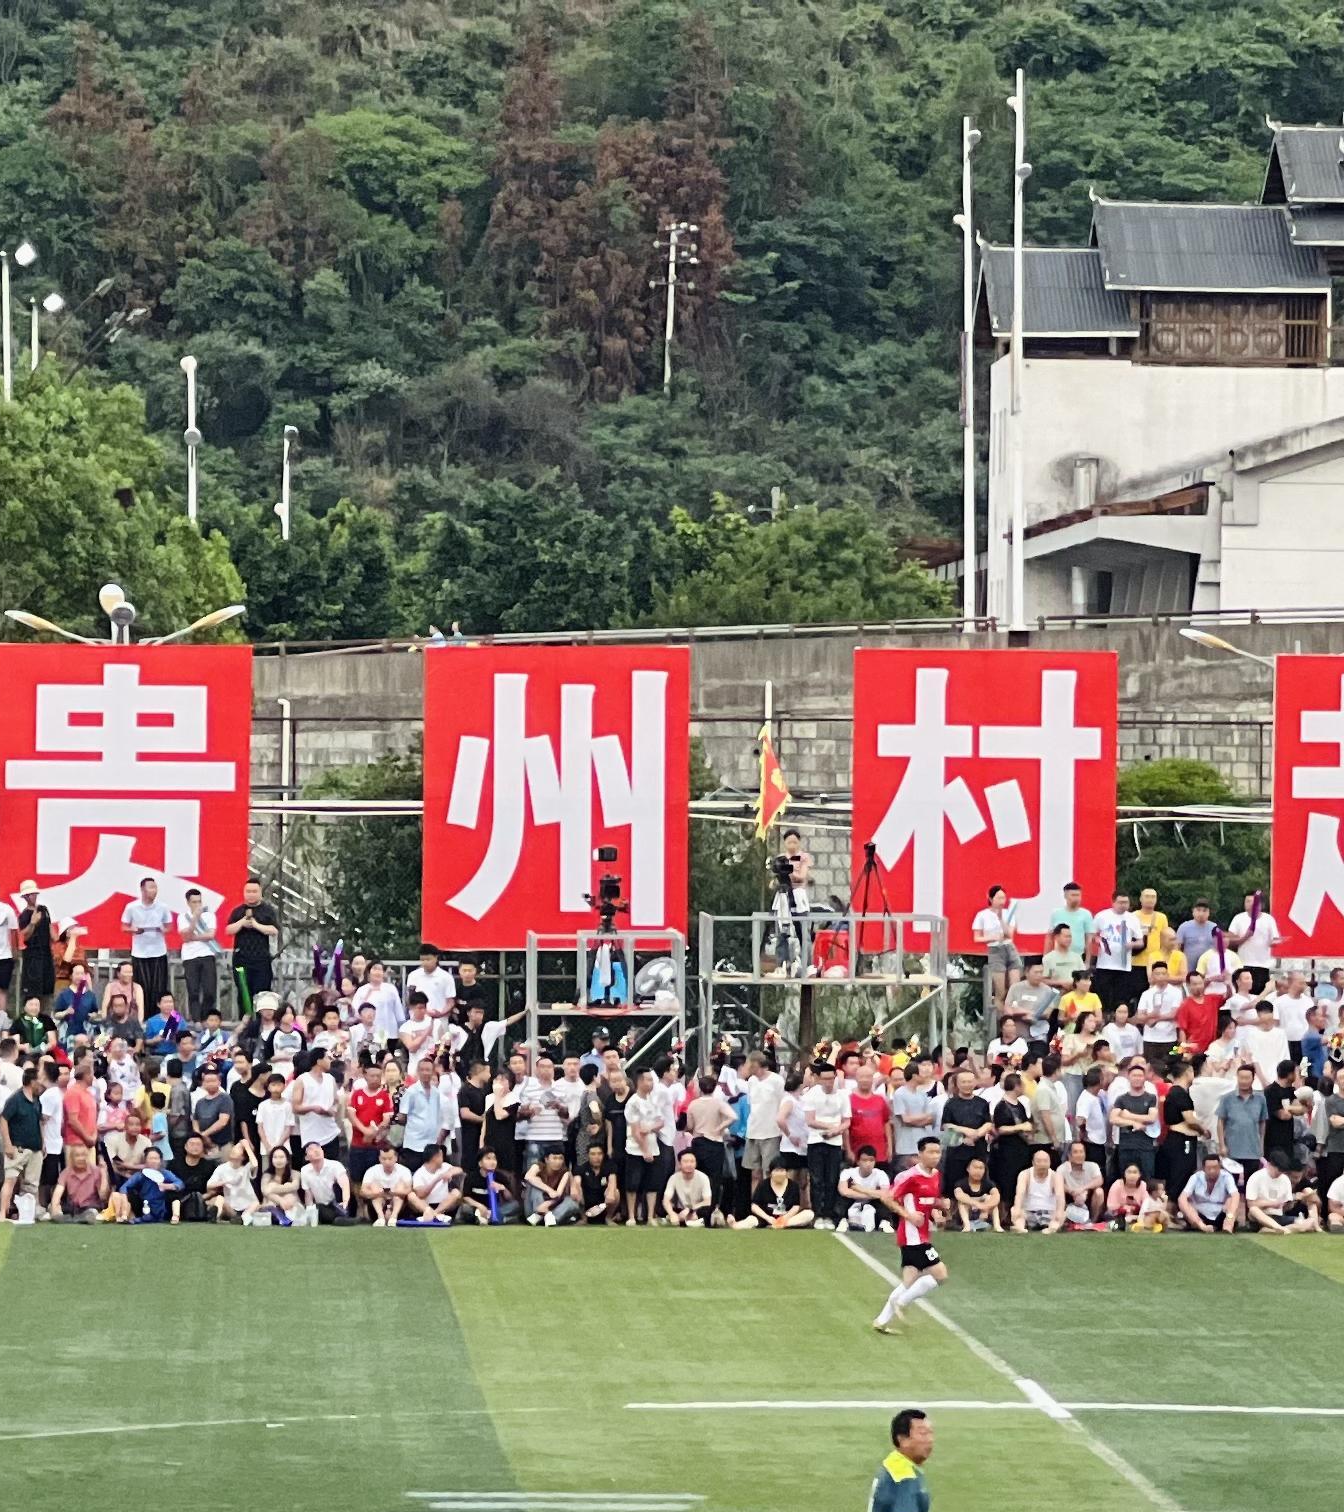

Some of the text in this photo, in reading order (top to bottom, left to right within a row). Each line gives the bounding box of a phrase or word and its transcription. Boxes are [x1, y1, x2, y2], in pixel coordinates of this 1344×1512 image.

[4, 662, 236, 916] 贵
[446, 670, 669, 928] 州
[872, 666, 1103, 936] 村
